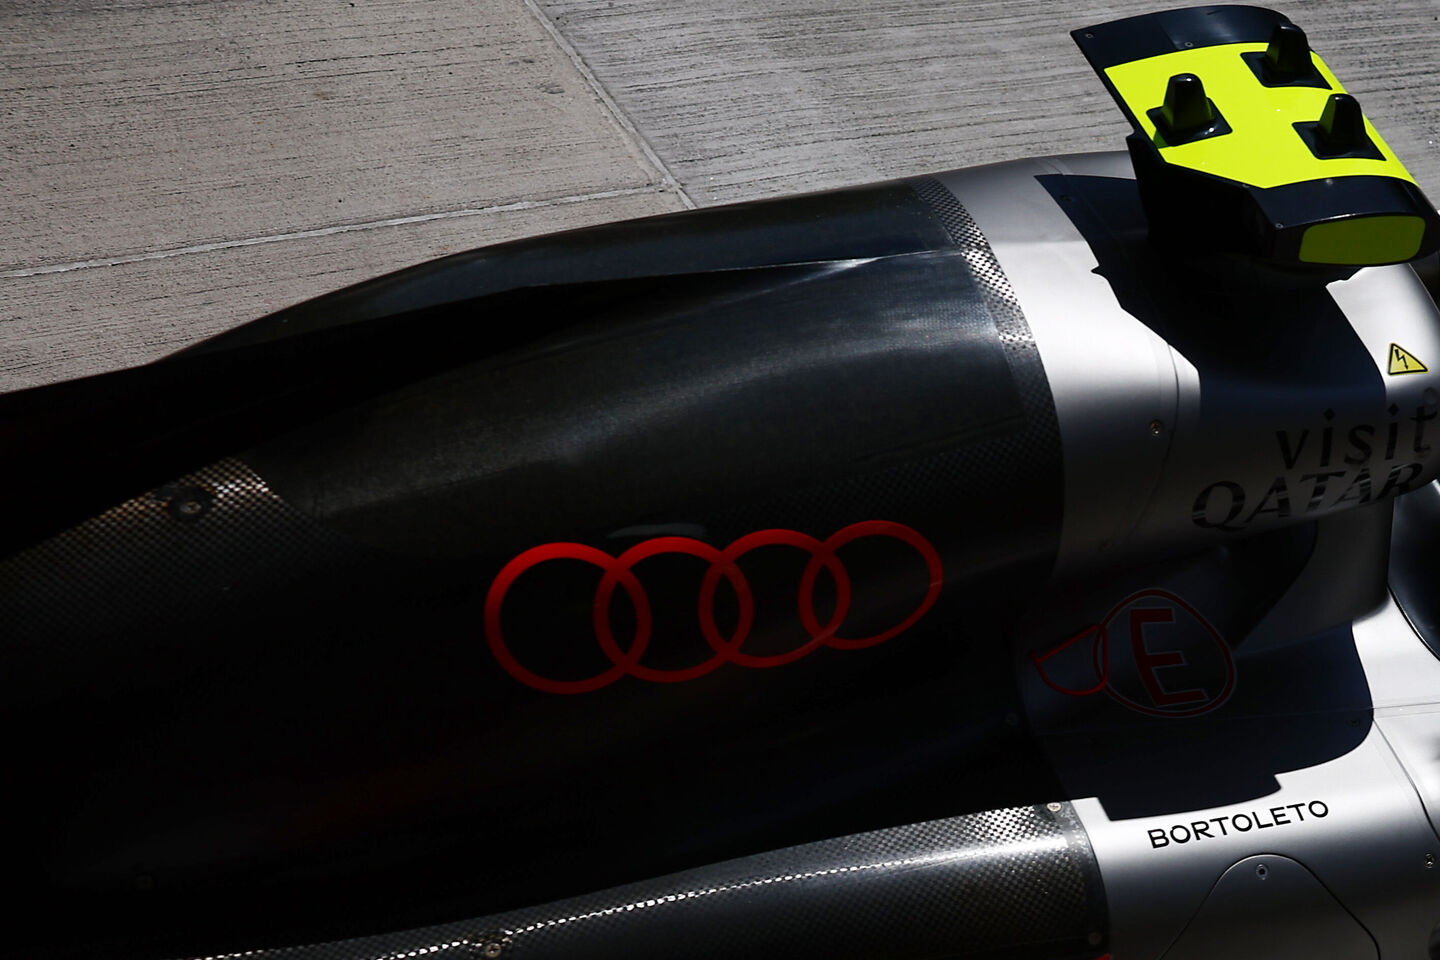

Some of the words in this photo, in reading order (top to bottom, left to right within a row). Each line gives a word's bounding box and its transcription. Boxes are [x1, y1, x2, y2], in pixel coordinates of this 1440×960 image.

[1276, 403, 1438, 470] visit
[1191, 462, 1423, 532] QATAR
[1147, 799, 1329, 850] BORTOLETO
